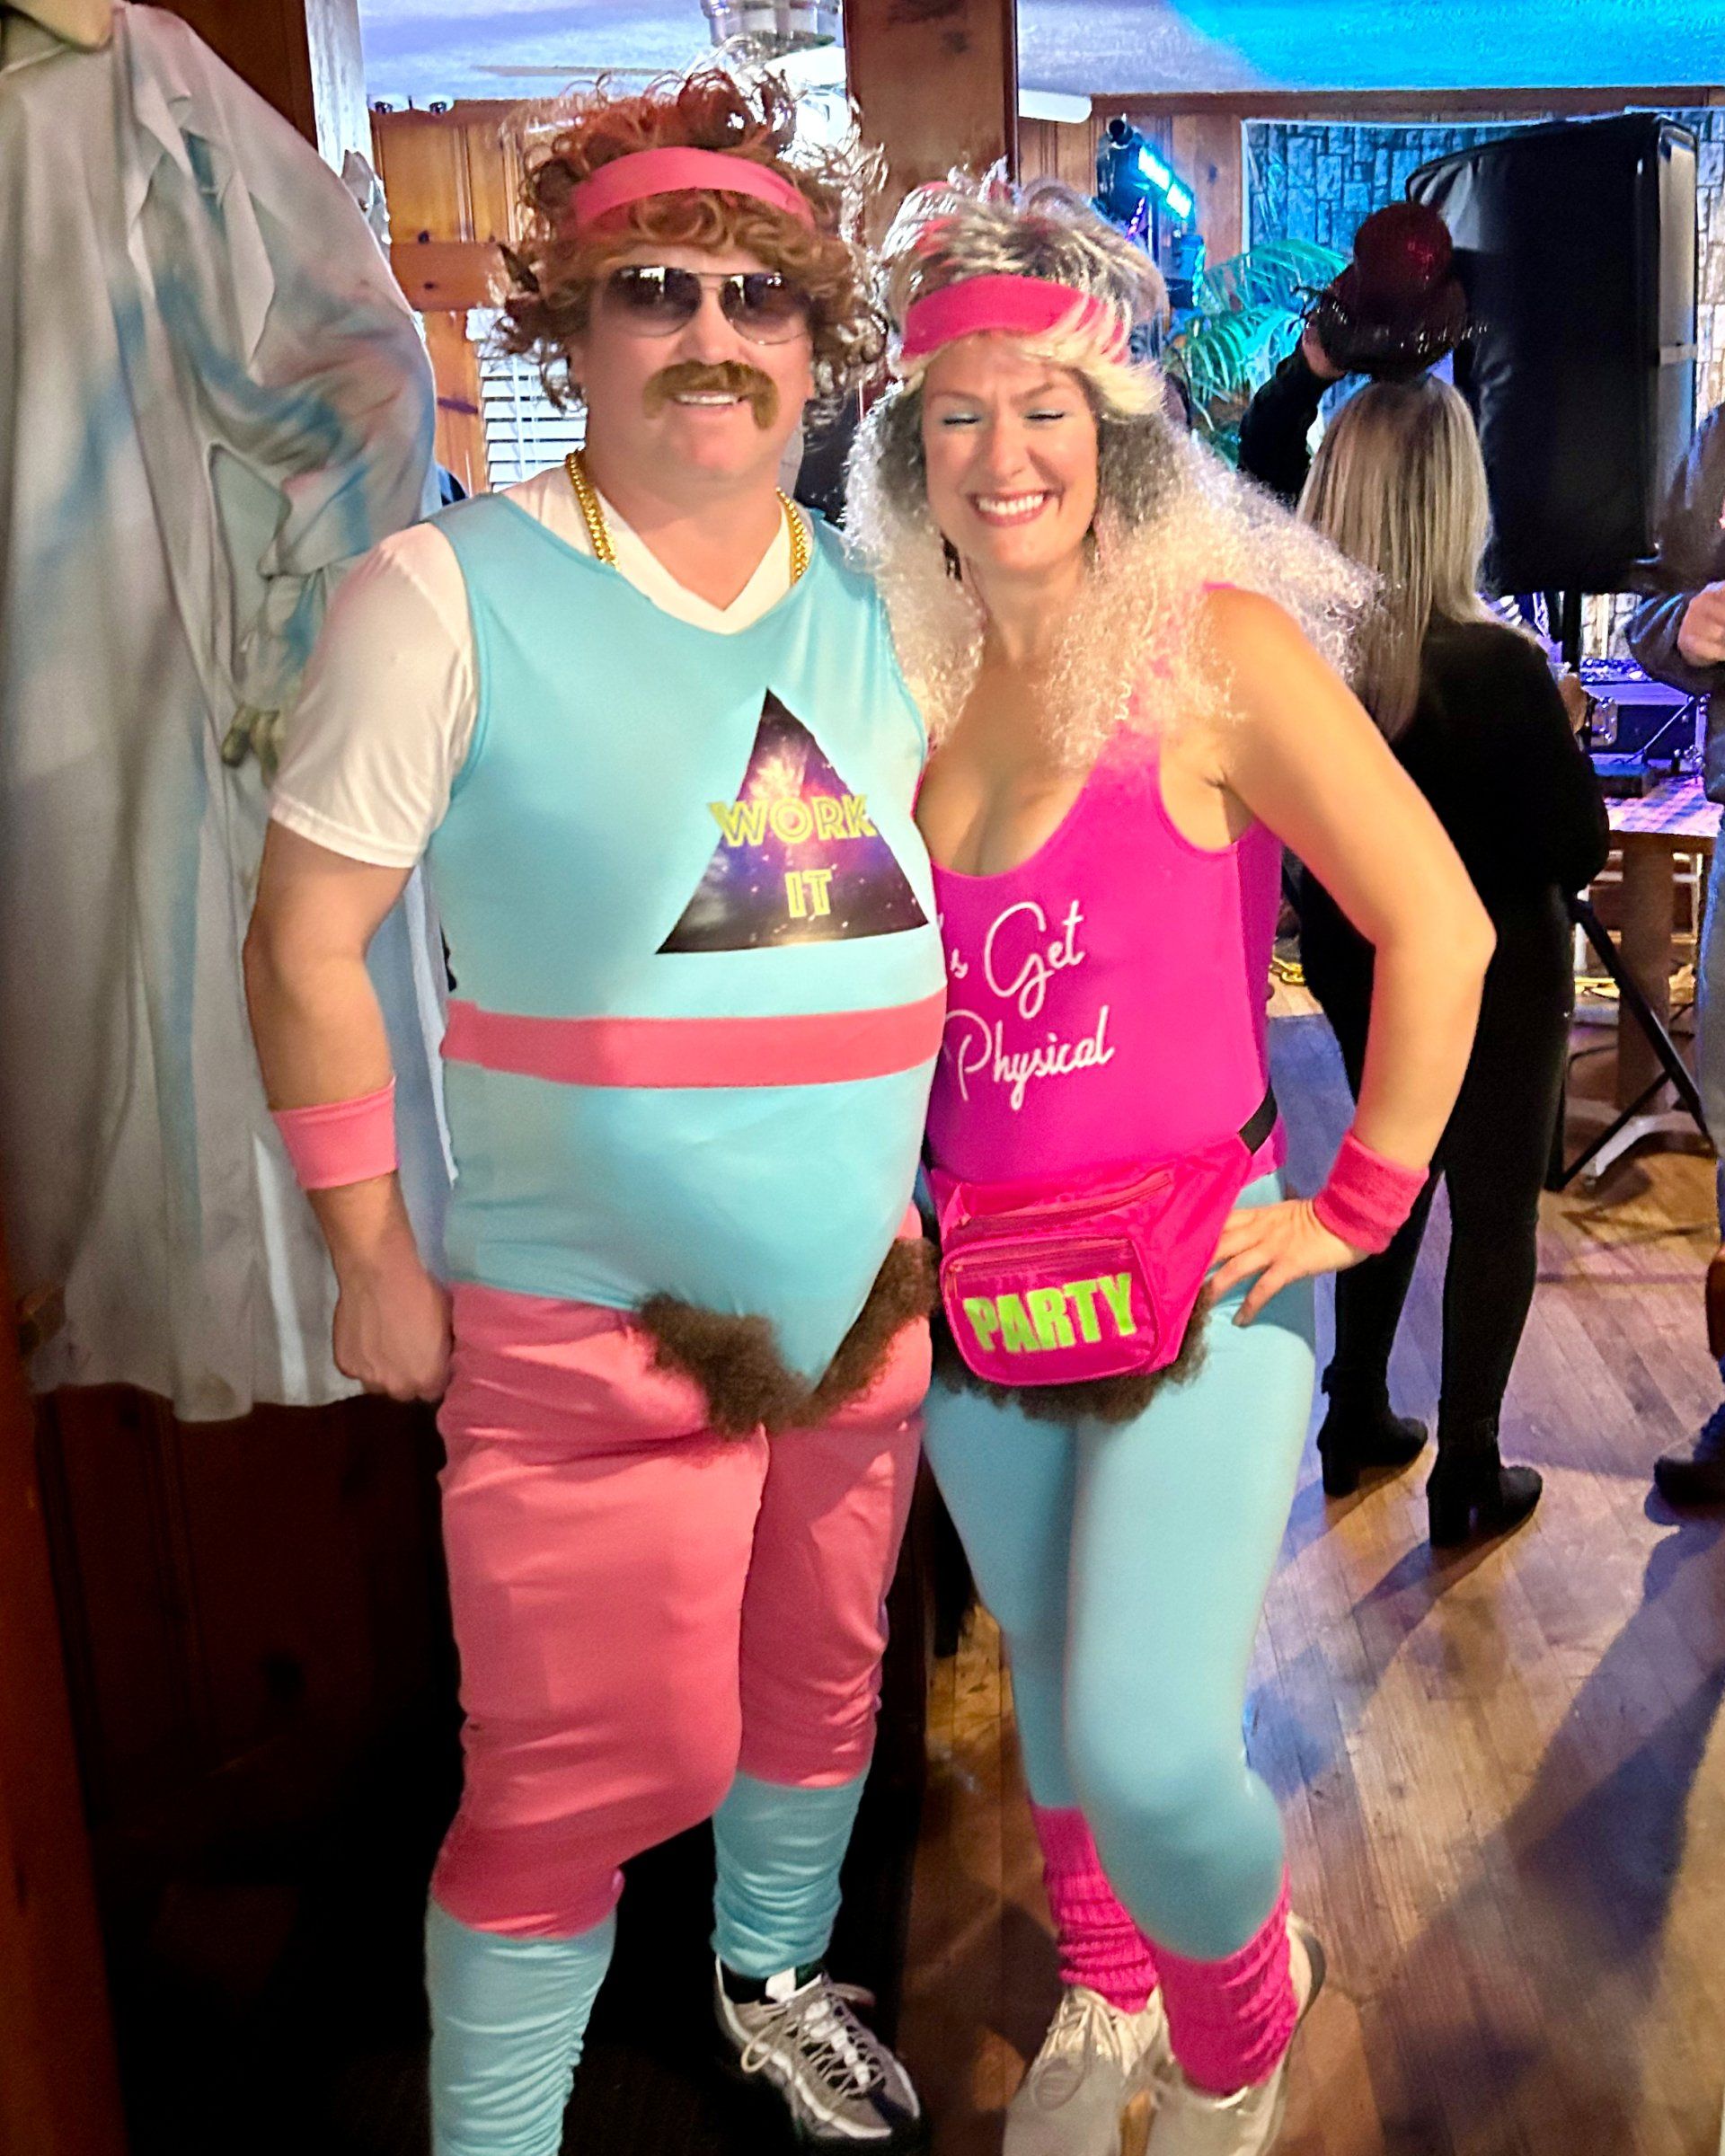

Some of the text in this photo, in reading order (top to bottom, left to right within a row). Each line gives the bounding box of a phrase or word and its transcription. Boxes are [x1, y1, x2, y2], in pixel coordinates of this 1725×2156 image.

[707, 794, 878, 847] WORK
[784, 869, 832, 918] IT
[984, 899, 1085, 1020] Get
[943, 1004, 1115, 1110] Physical
[963, 1272, 1137, 1354] PARTY
